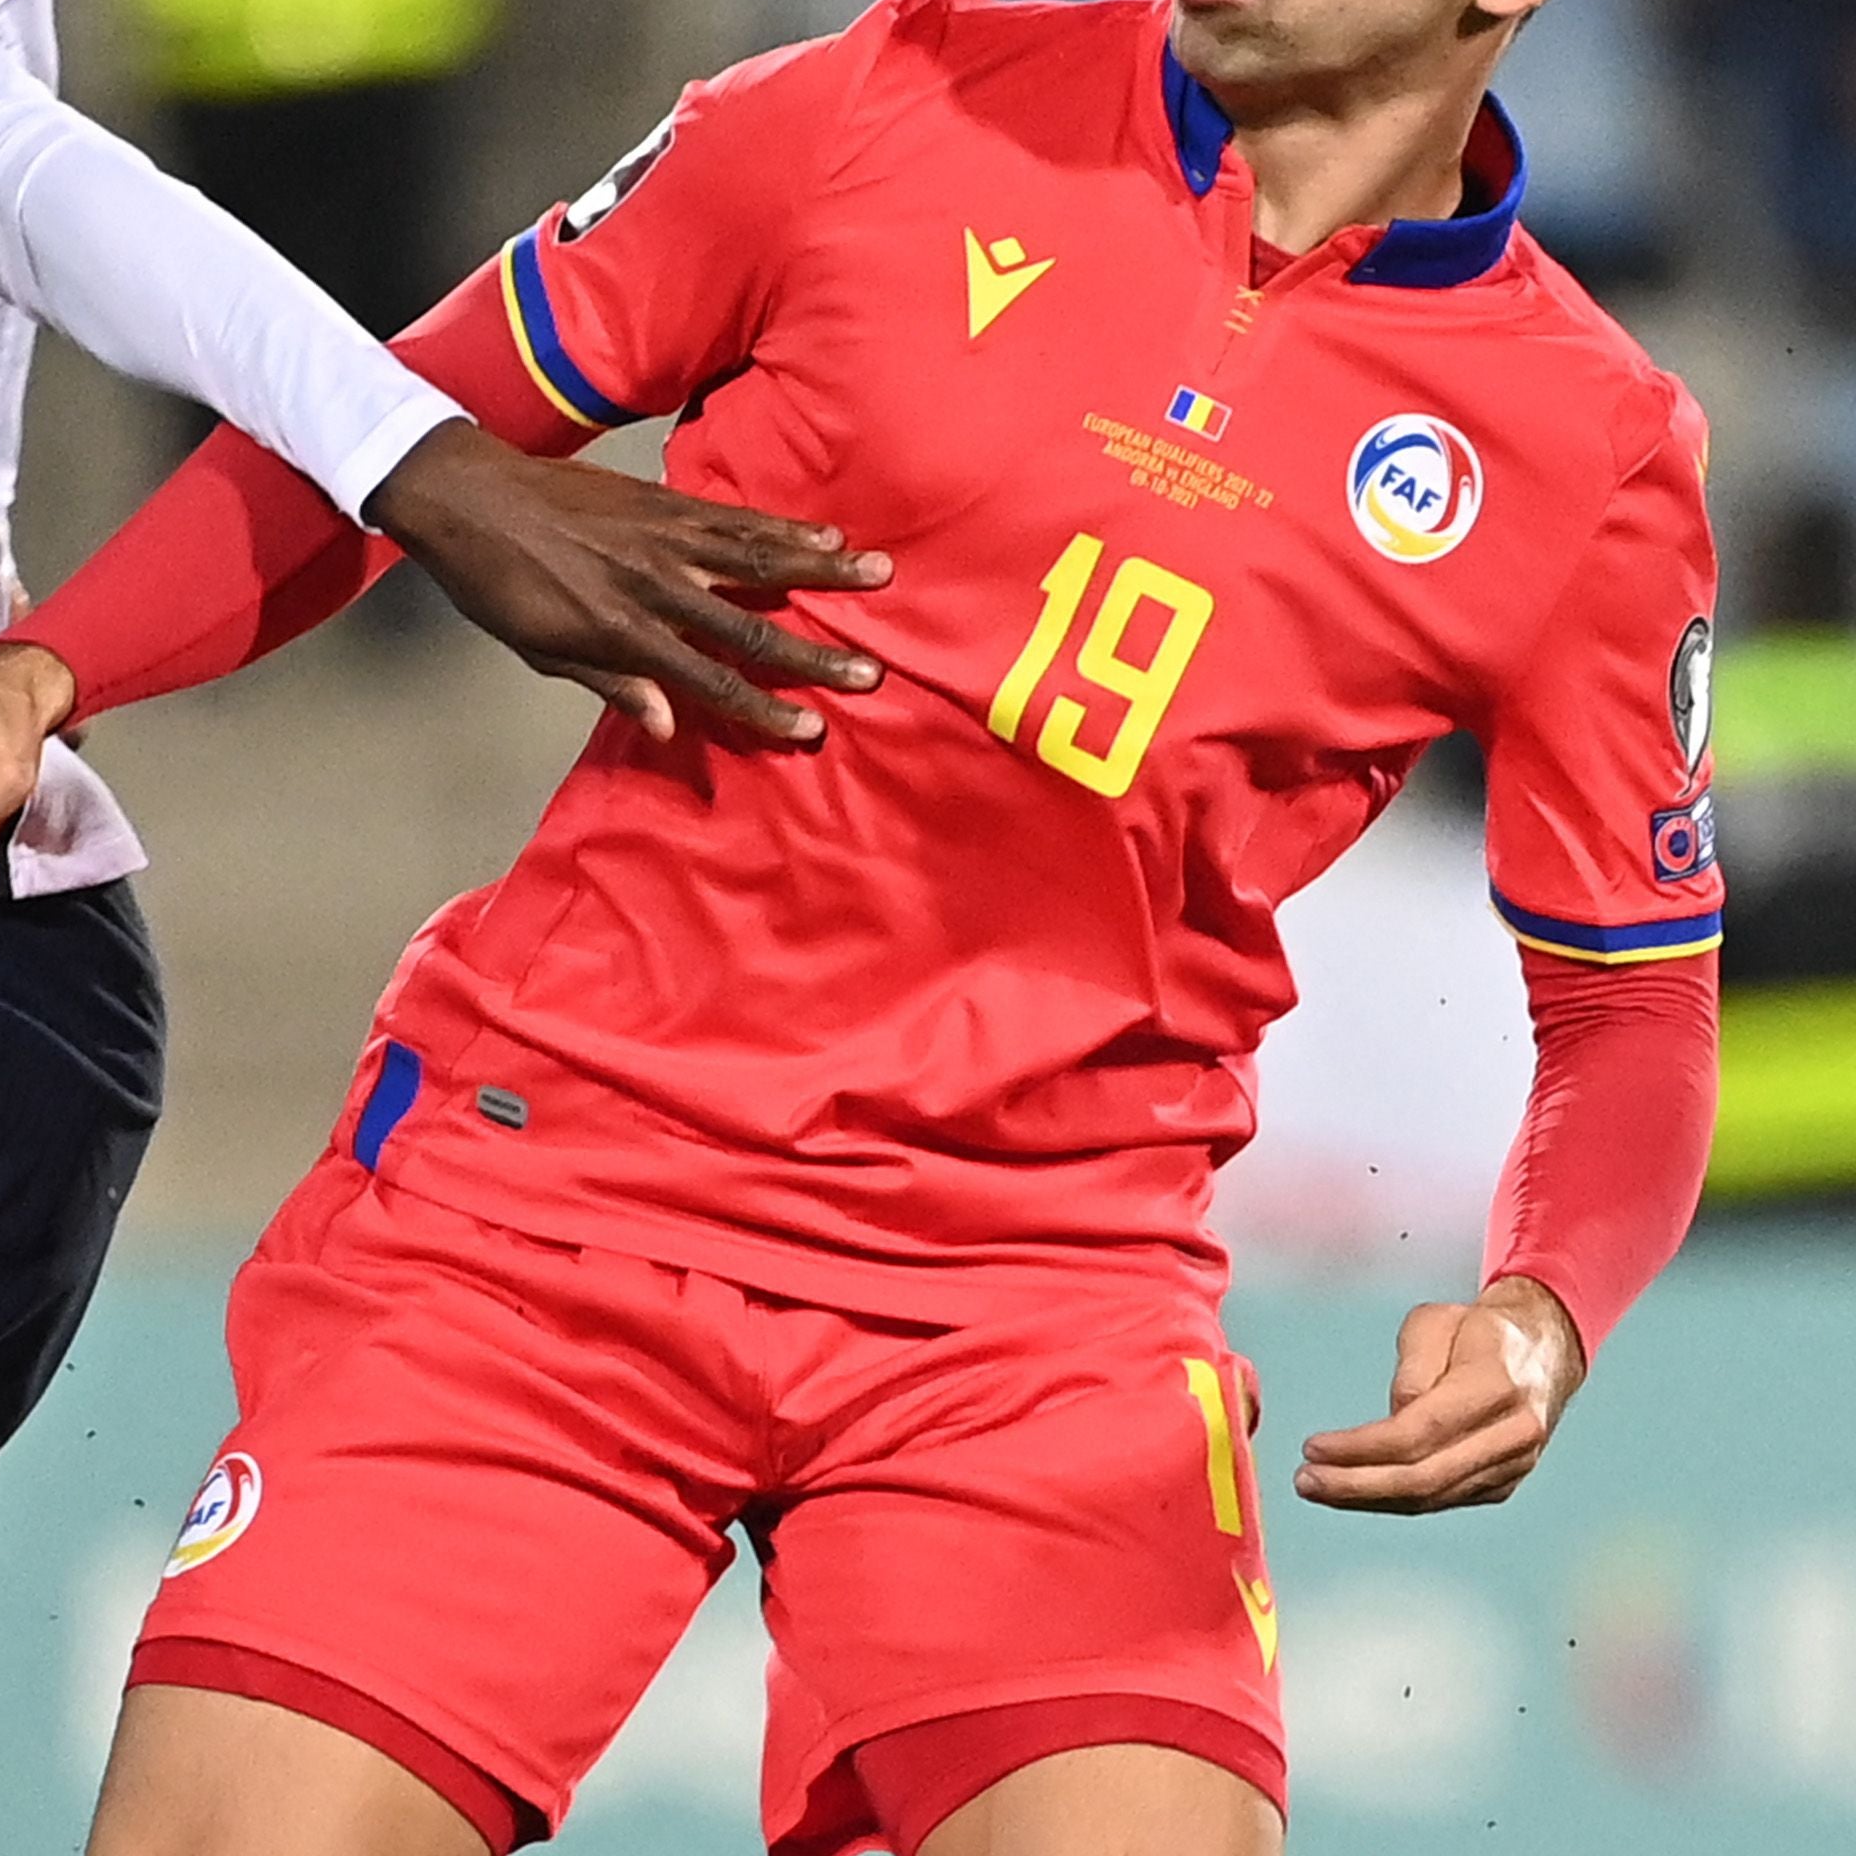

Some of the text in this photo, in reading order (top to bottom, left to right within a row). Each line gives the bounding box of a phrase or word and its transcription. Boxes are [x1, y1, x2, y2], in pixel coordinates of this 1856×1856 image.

[1083, 413, 1150, 450] EUROPEAN
[1153, 438, 1225, 481] QUALIFIERS
[1103, 440, 1164, 471] ANDORRA
[1180, 470, 1240, 510] ENGLAND
[1380, 464, 1441, 514] FAF
[989, 532, 1214, 798] 19
